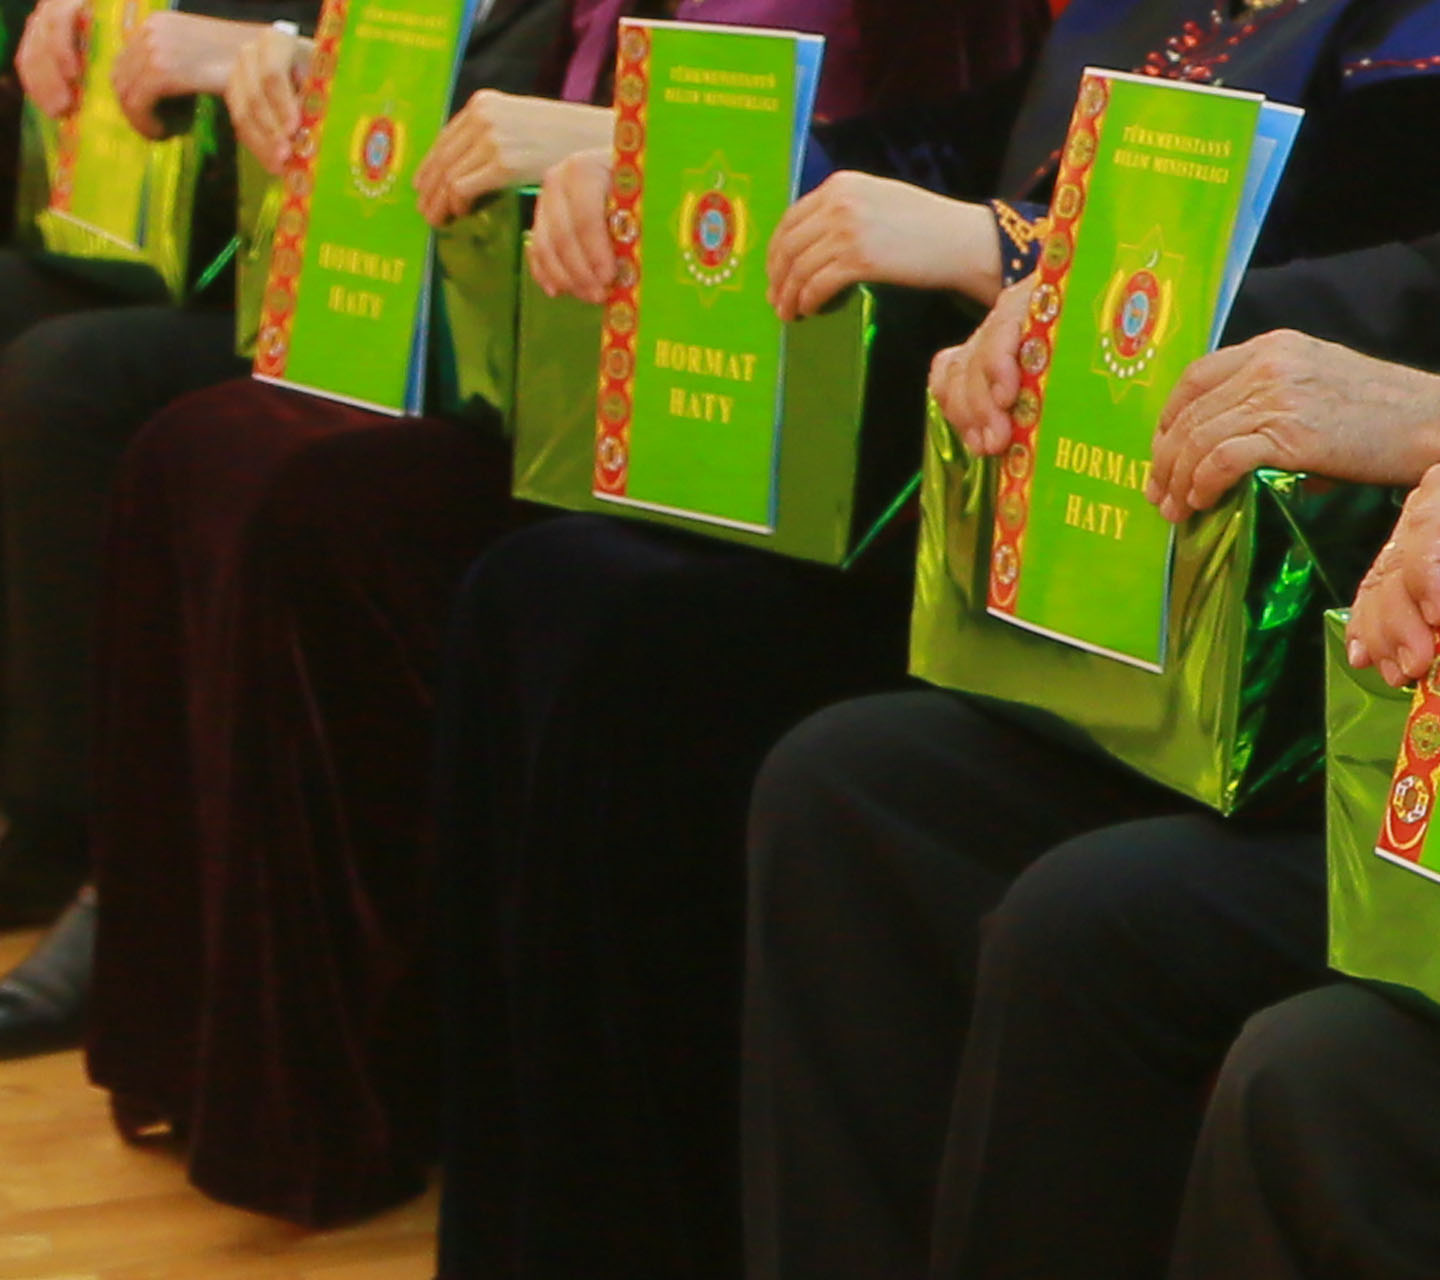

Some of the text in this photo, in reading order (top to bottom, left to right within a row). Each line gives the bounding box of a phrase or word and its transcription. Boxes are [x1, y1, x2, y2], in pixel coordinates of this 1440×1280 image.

[653, 338, 757, 382] HORMAT
[669, 387, 736, 425] HATY
[1054, 436, 1152, 493] HORMAT
[1065, 493, 1130, 541] HATY
